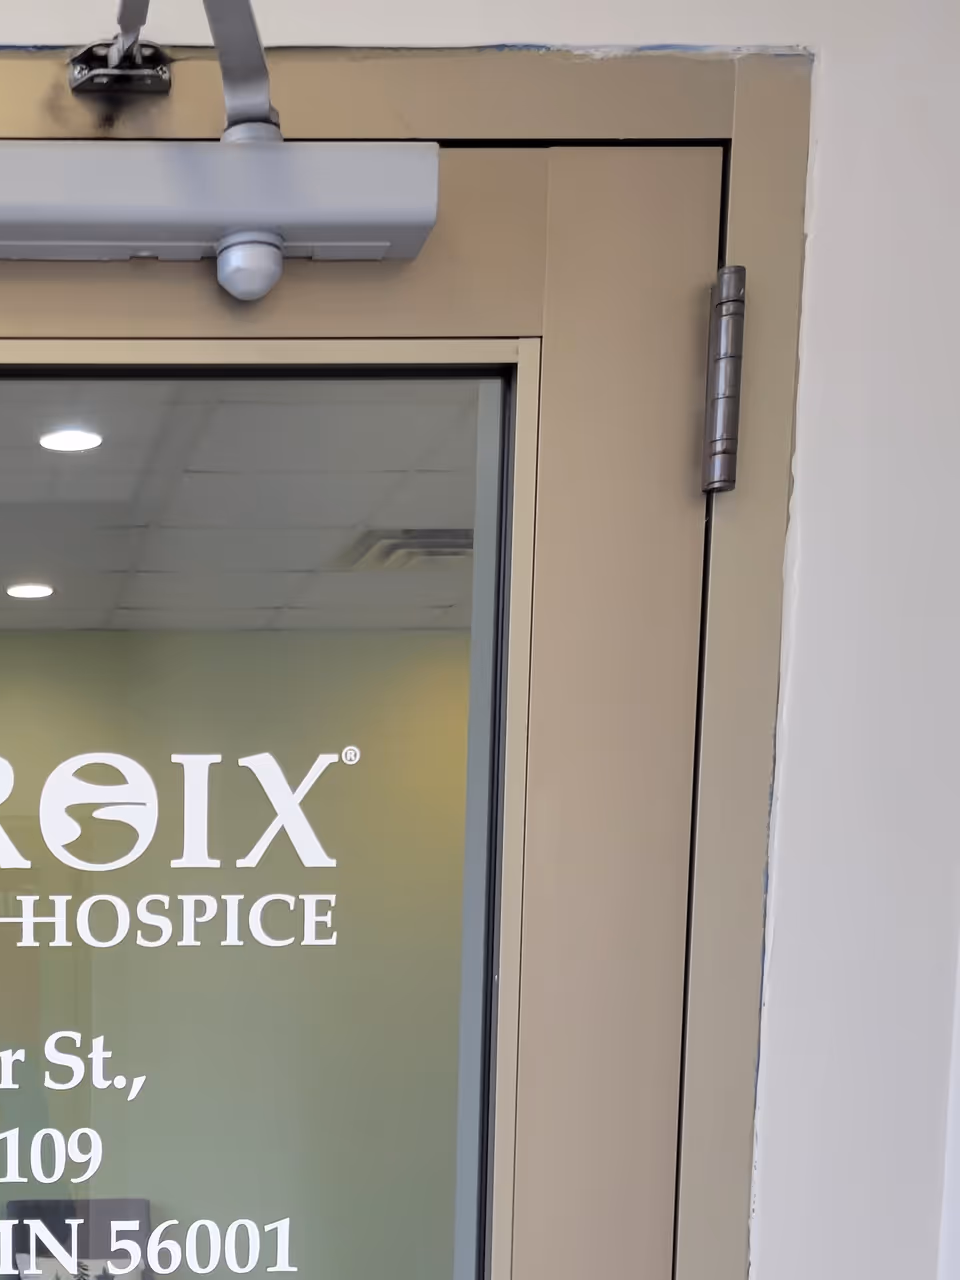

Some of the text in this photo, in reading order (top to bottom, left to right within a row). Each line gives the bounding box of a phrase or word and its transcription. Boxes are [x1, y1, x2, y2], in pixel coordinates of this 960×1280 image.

[16, 893, 338, 948] HOSPICE
[43, 1030, 147, 1102] St.,
[106, 1217, 299, 1275] 56001
